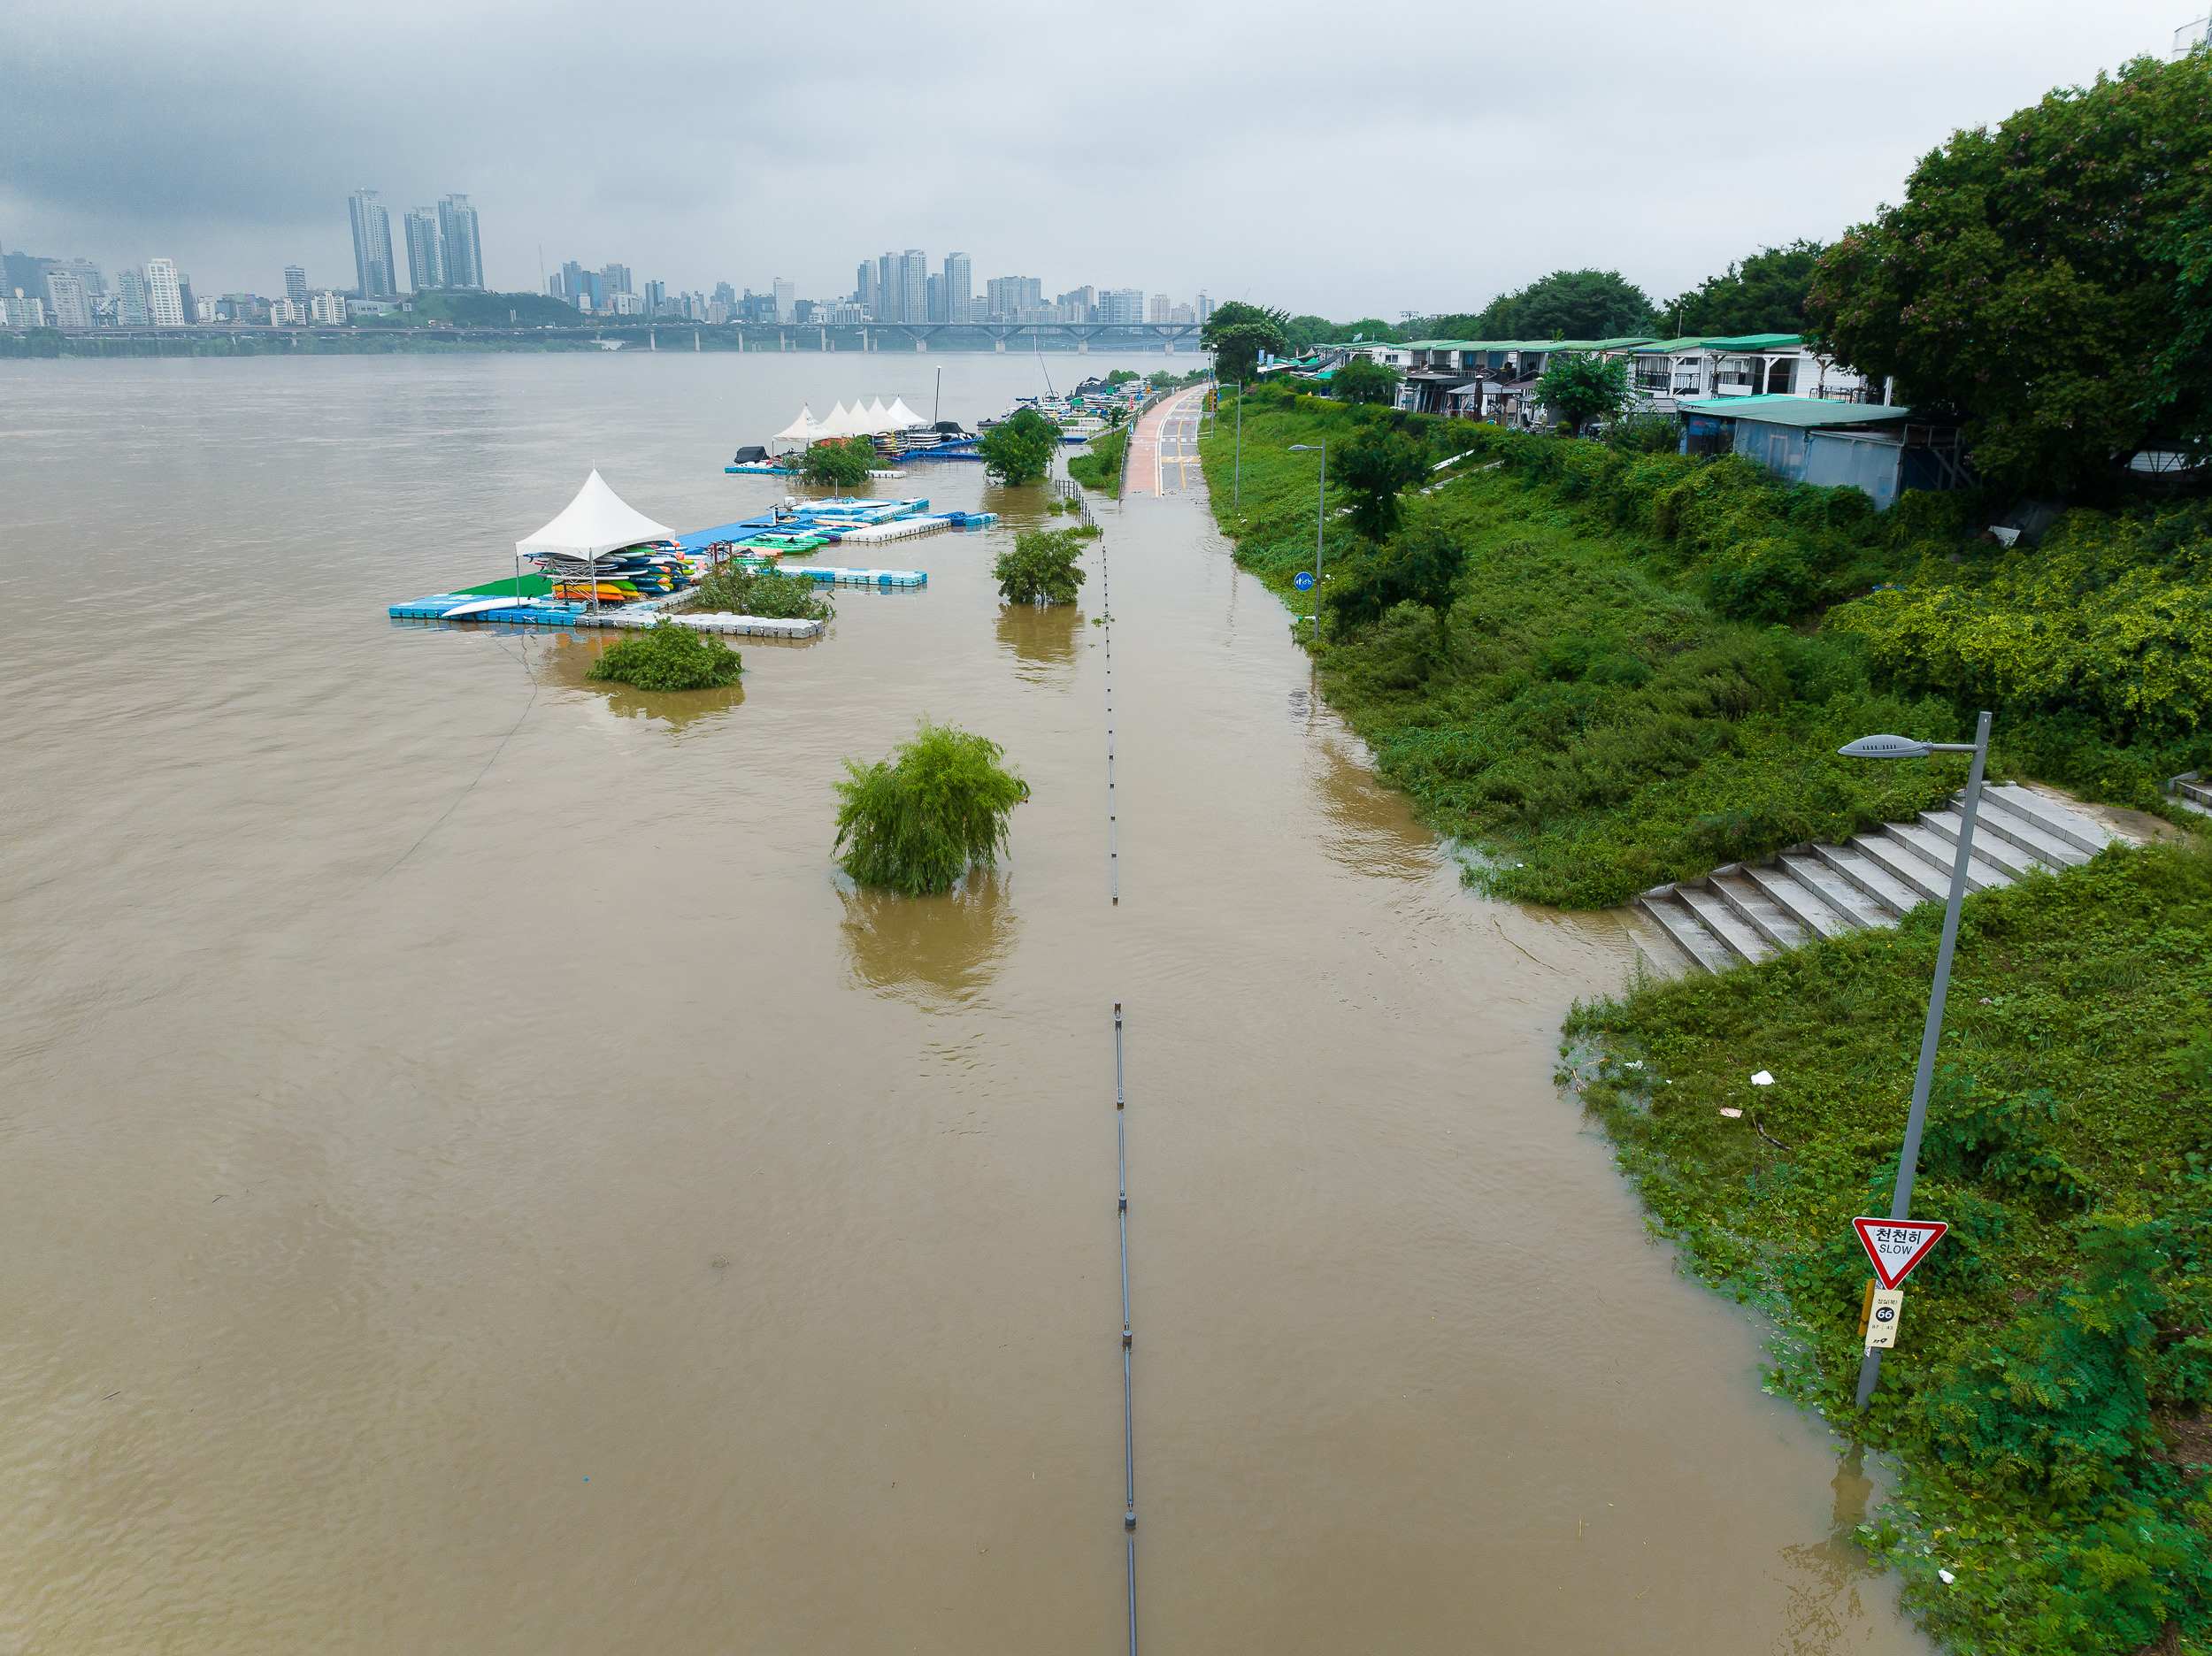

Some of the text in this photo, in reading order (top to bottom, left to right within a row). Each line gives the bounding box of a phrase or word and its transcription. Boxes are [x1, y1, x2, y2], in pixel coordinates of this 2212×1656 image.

[1876, 1228, 1922, 1245] 천천히
[1878, 1243, 1913, 1255] SLOW
[1877, 1309, 1893, 1319] 66
